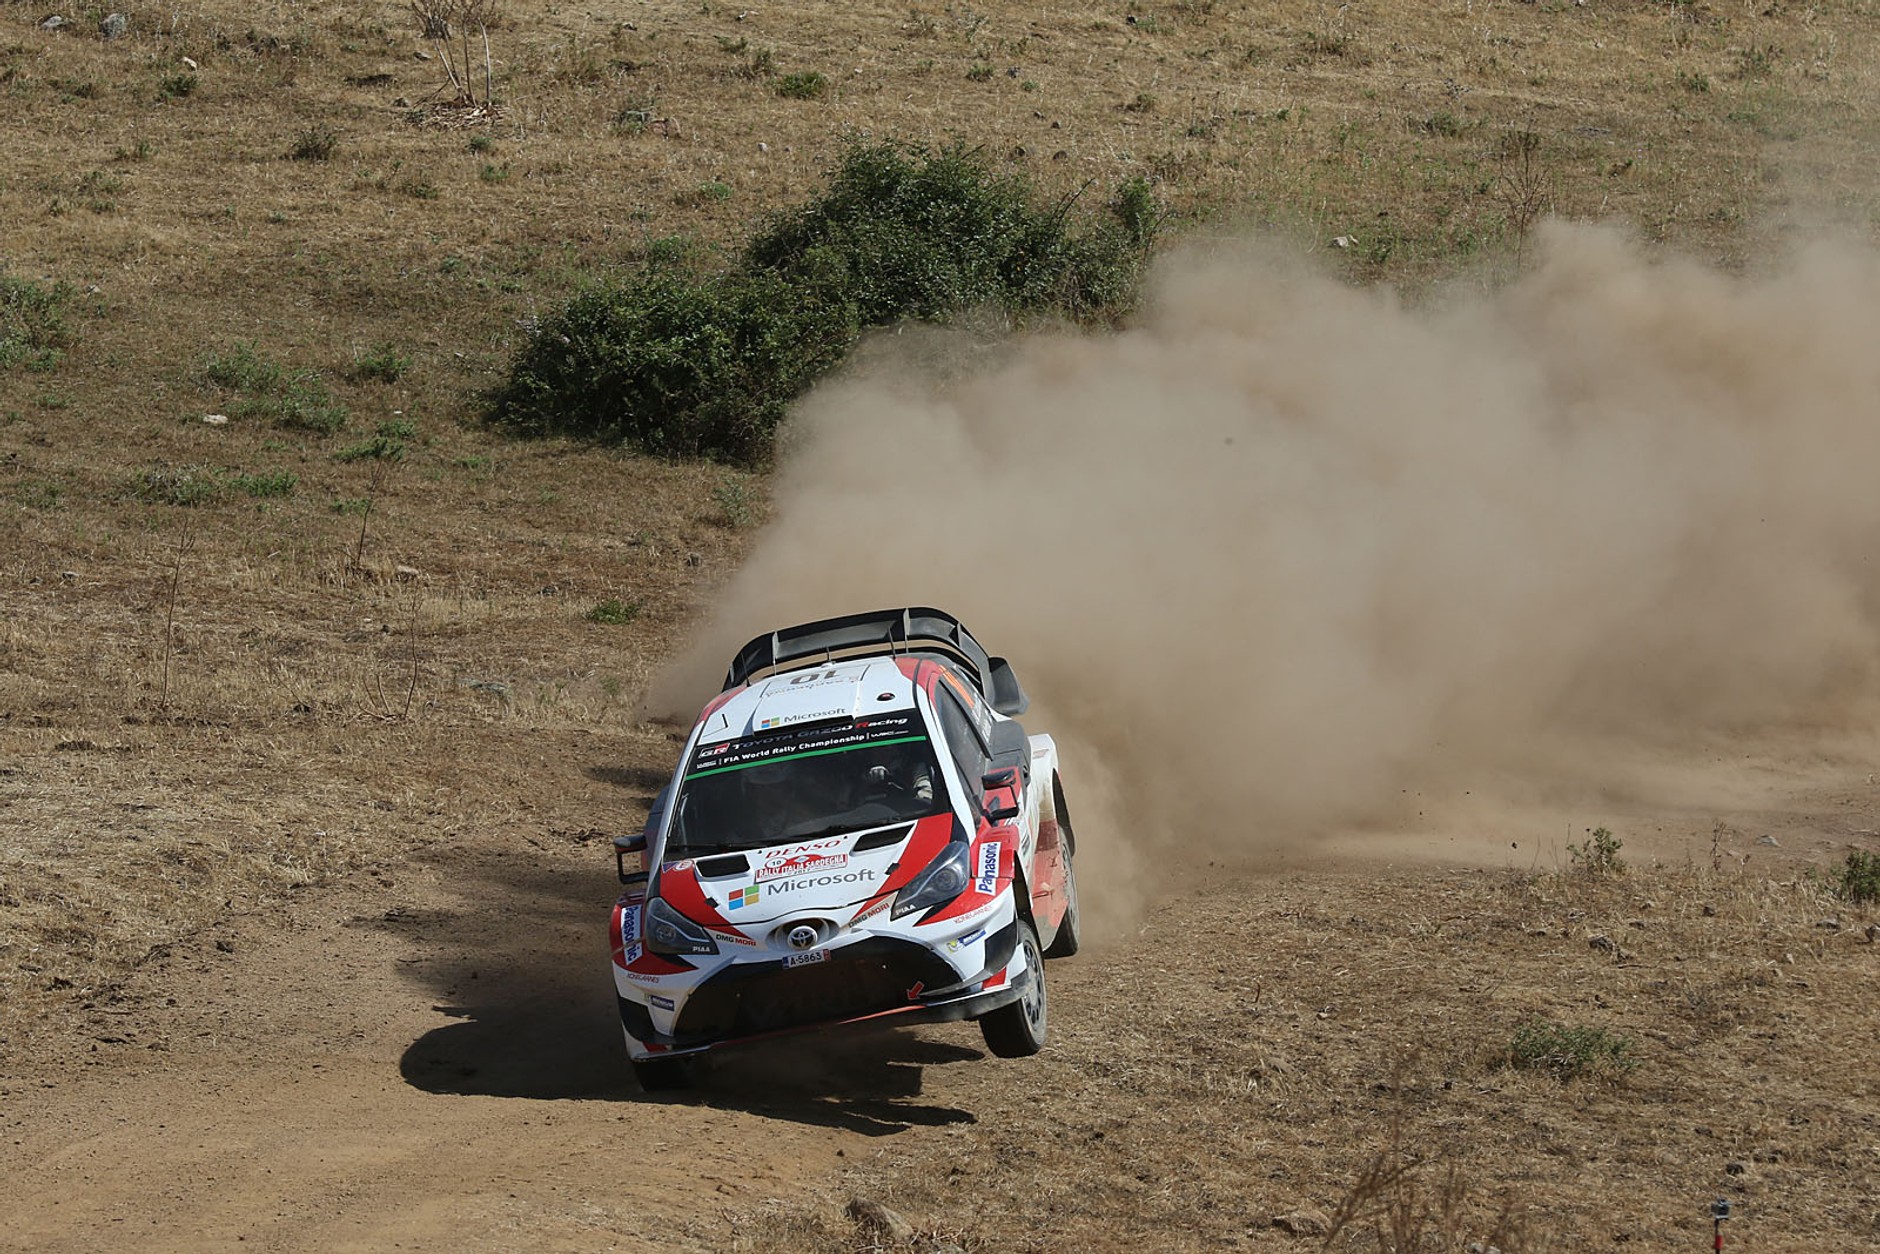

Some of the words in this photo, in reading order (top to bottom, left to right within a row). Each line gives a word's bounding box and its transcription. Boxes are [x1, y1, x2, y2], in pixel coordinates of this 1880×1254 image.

[784, 708, 846, 722] Microsoft
[856, 718, 908, 729] Racing
[724, 756, 740, 764] FIA
[742, 750, 770, 760] World
[772, 745, 797, 756] Rally
[798, 733, 865, 750] Championship
[766, 840, 841, 859] DENSO
[760, 867, 780, 878] RALLY
[782, 863, 804, 874] ITALIA
[805, 855, 844, 870] SARDEGNA
[979, 843, 998, 893] Panasonic
[768, 869, 875, 896] Microsoft
[849, 914, 868, 928] DMG
[868, 903, 890, 919] MORI
[895, 904, 916, 915] PIAA
[624, 906, 640, 962] Panasonic
[716, 934, 735, 943] DMG
[735, 938, 757, 947] MORI
